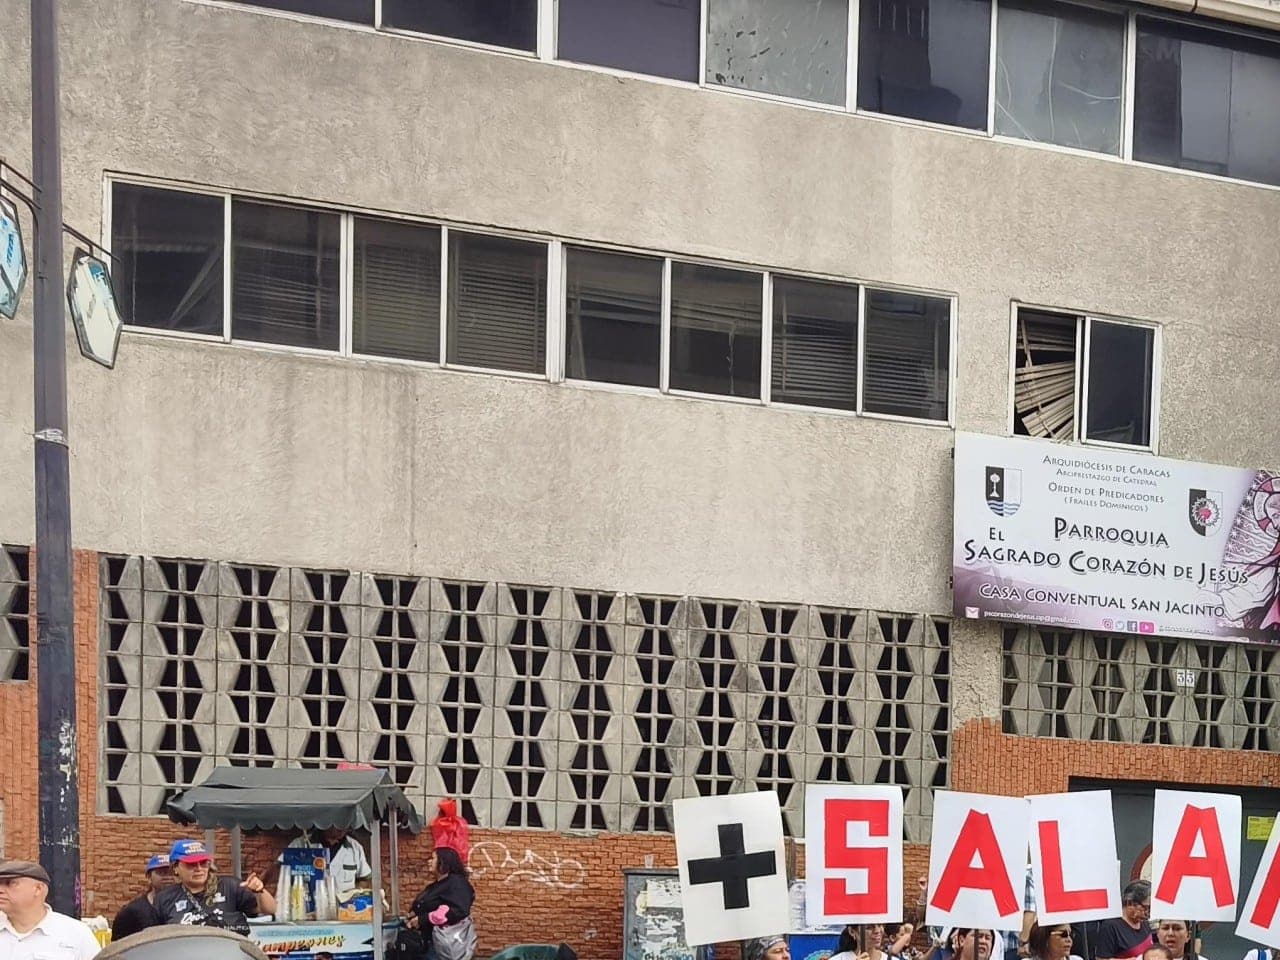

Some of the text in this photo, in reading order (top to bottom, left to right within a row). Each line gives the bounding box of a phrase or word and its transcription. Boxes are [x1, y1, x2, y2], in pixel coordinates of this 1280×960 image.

[1123, 476, 1157, 487] CATEDRAL
[1129, 465, 1170, 478] CARACAS
[1048, 482, 1165, 503] ORDEN DE PREDICADORES
[989, 527, 1005, 541] EL
[1054, 517, 1169, 547] PARROQUIA
[964, 539, 1249, 585] SAGRADO CORAZÓN DE JESÚS
[980, 583, 1226, 619] CASA CONVENTUAL SAN JACINTO
